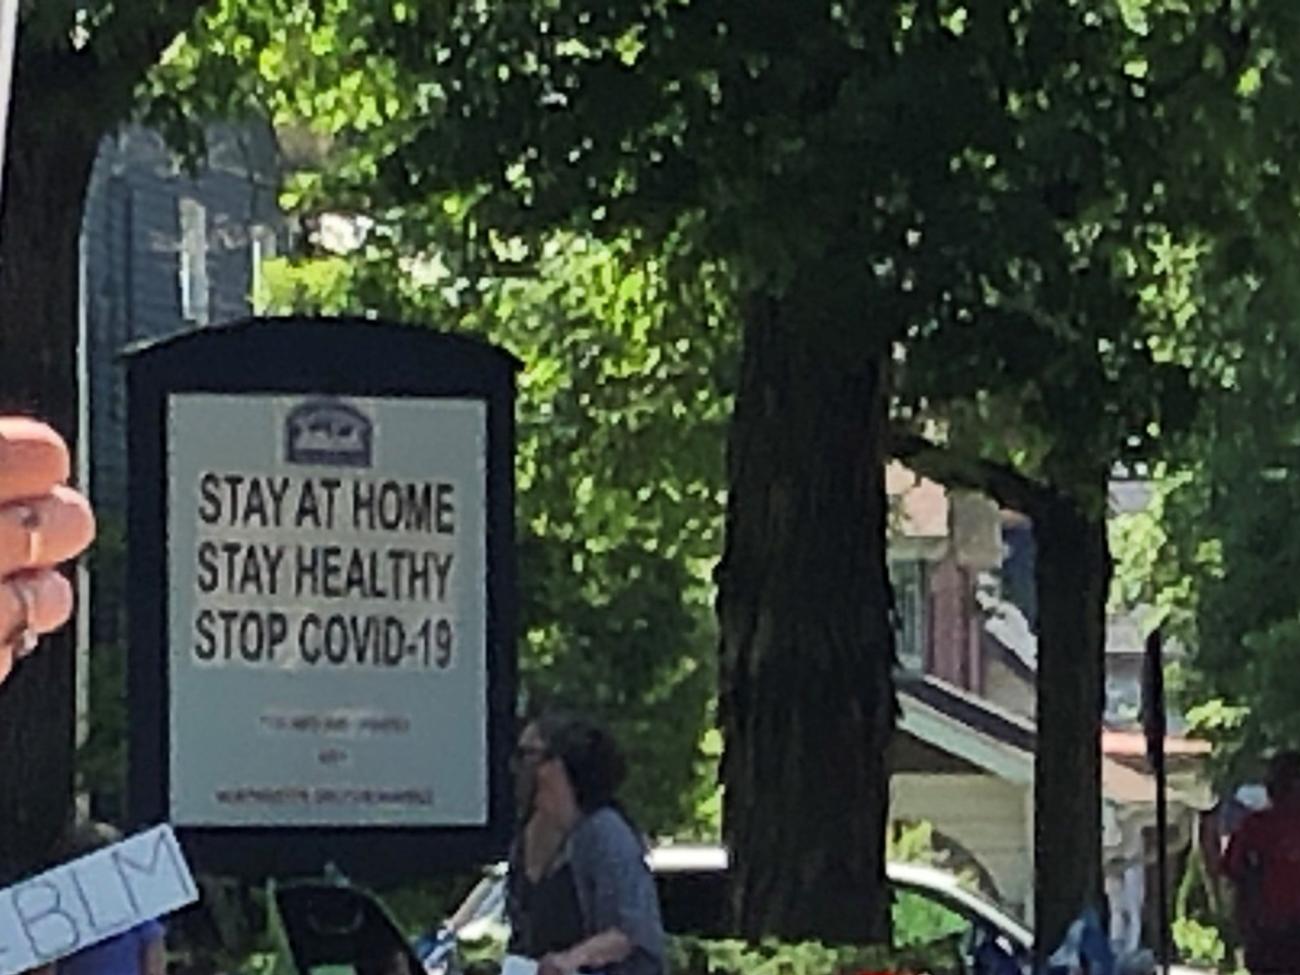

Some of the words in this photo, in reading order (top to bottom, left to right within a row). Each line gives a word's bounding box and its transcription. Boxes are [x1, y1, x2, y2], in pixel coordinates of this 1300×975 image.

[198, 473, 290, 527] STAY
[295, 478, 342, 530] AT
[353, 480, 455, 535] HOME
[198, 541, 284, 594] STAY
[295, 546, 453, 602] HEALTHY
[194, 609, 288, 661] STOP
[299, 613, 453, 669] COVID-19
